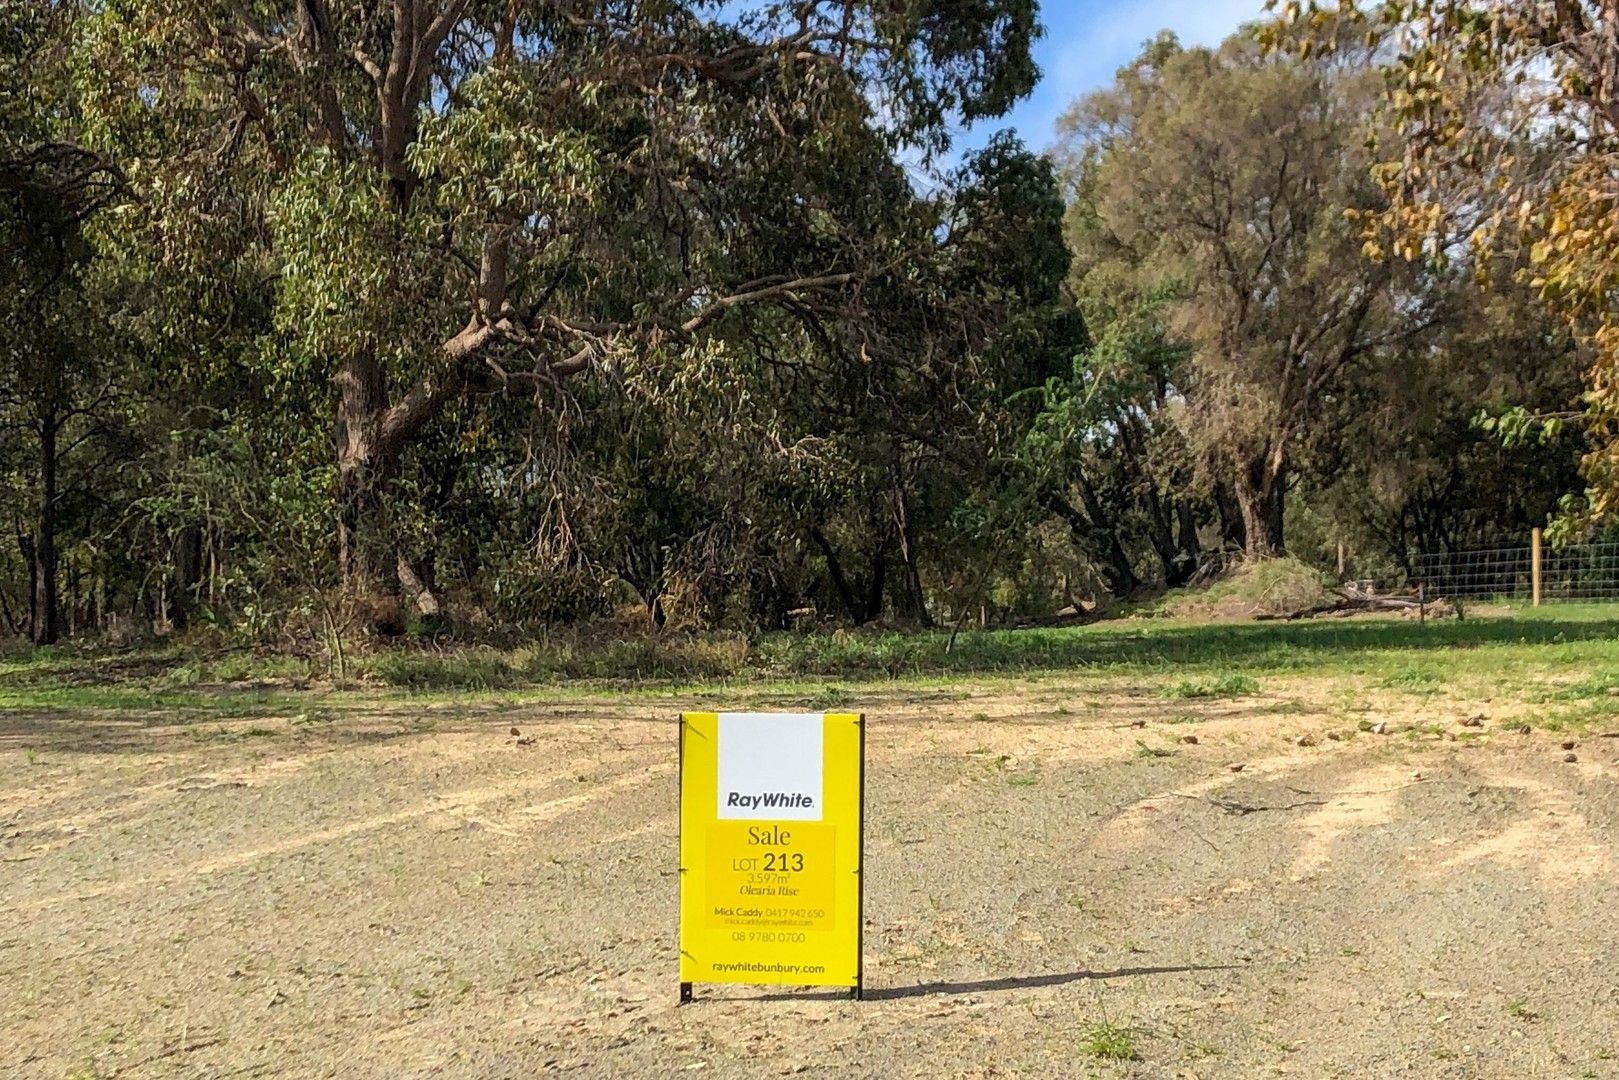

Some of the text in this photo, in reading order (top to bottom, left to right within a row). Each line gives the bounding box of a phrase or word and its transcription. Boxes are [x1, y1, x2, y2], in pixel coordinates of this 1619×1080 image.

[748, 825, 791, 846] Sale
[732, 852, 804, 872] LOT 213
[739, 885, 800, 896] Olearia Rise
[714, 907, 734, 916] Mick
[736, 907, 763, 918] Caddy
[731, 931, 806, 943] 08 9780 0700
[712, 962, 825, 975] raywhitebunbury.com
